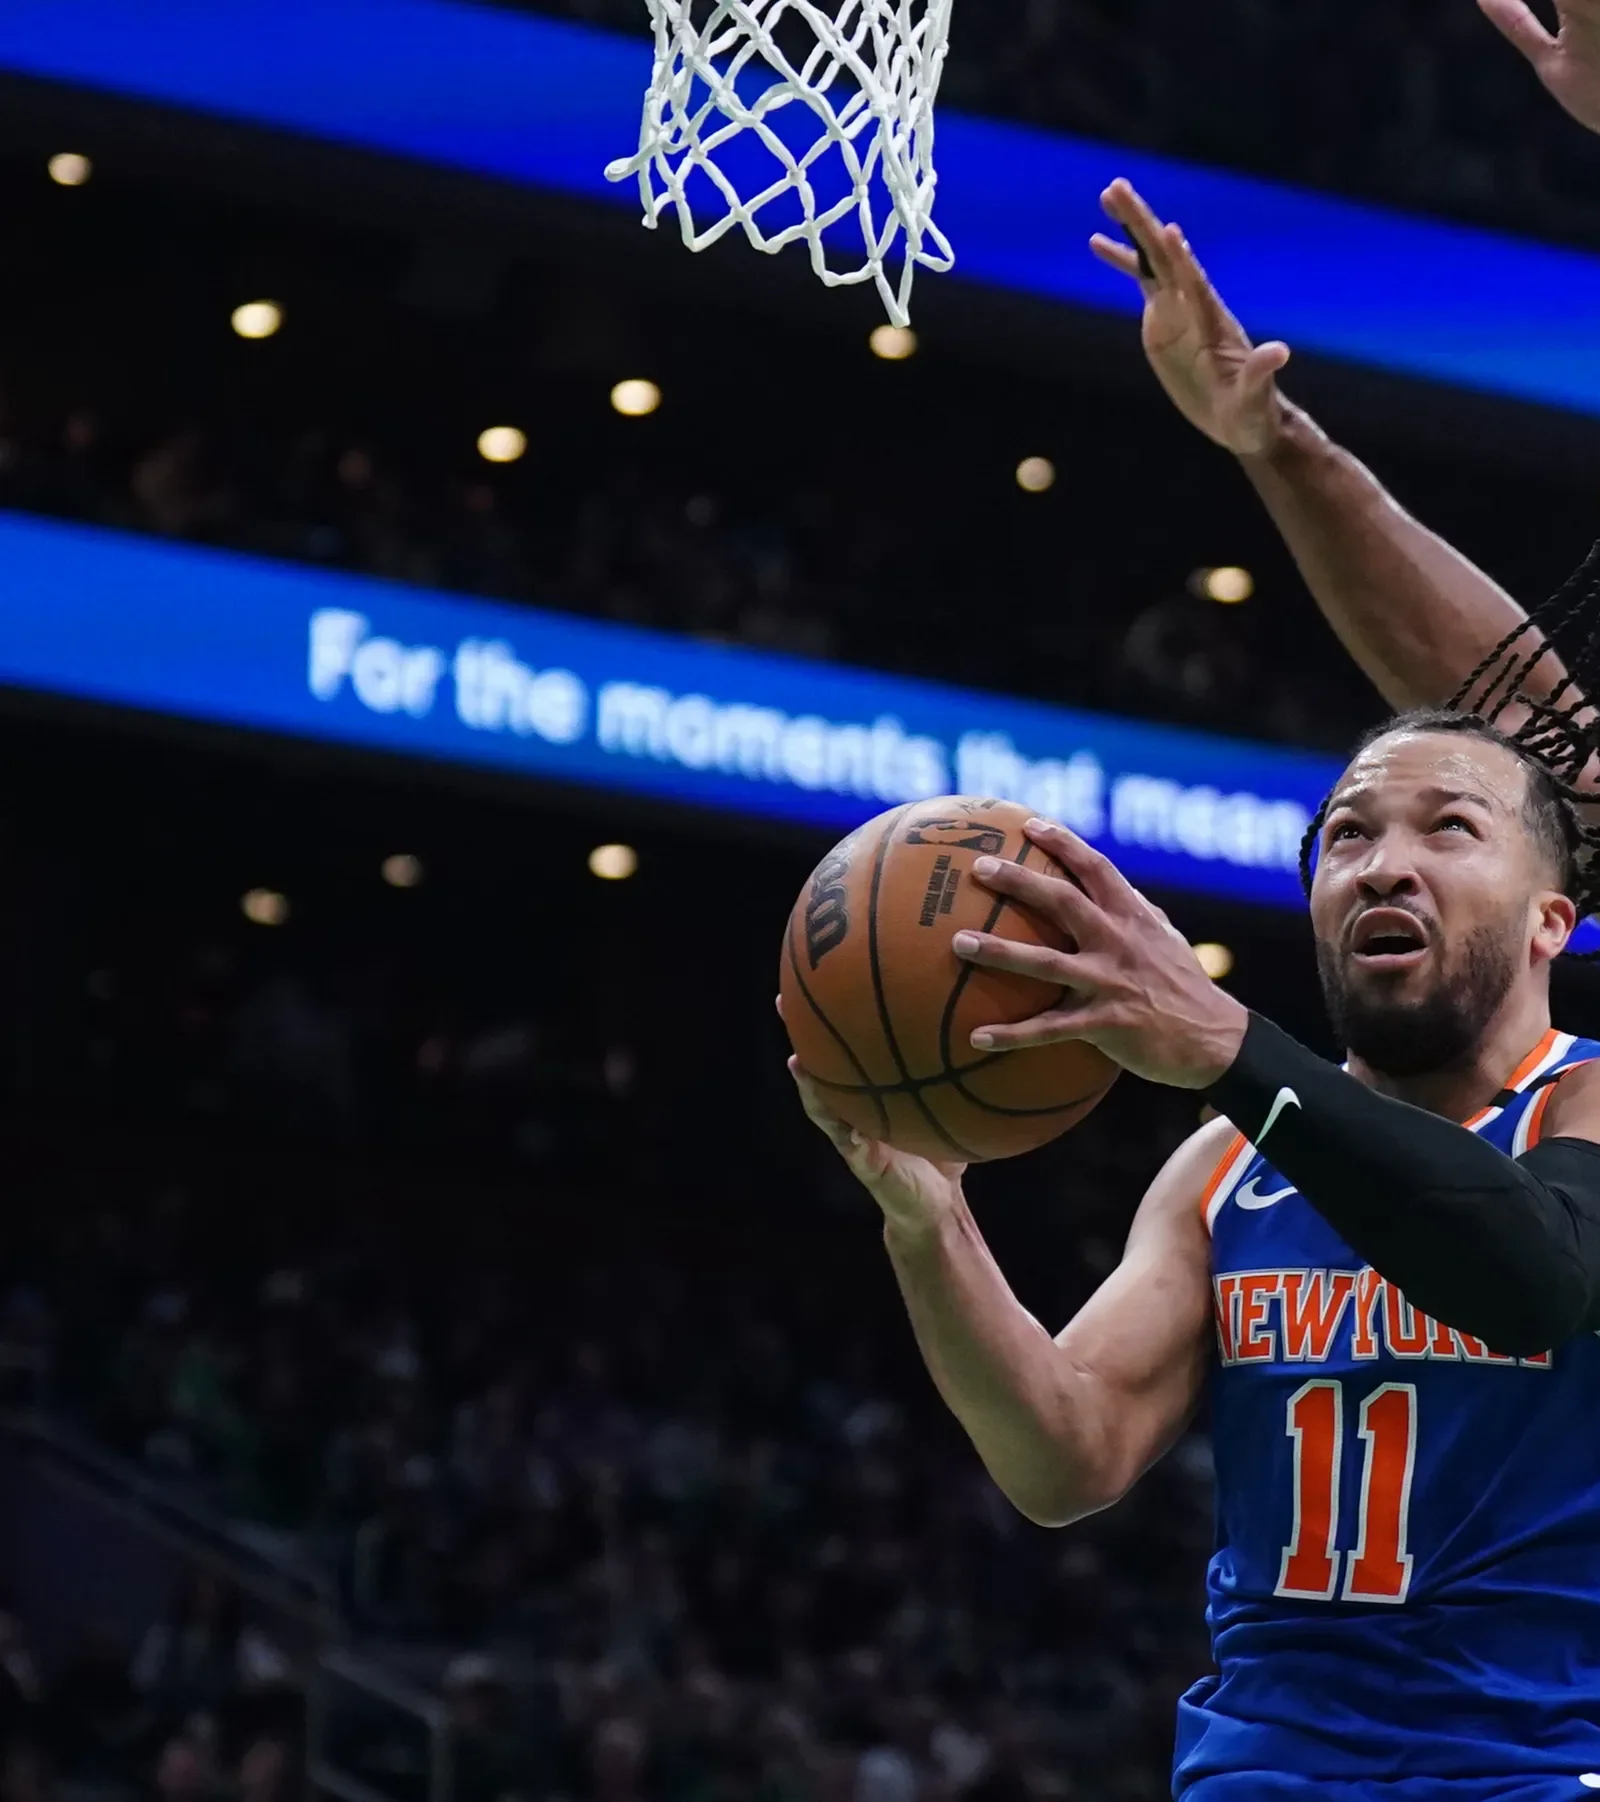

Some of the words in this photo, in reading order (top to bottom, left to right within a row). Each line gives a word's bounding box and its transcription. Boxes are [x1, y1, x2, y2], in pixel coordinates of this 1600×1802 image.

[308, 607, 446, 719] For
[452, 635, 589, 746] the
[597, 680, 953, 809] moments
[955, 730, 1104, 838] that
[1108, 771, 1312, 874] mean
[1273, 1378, 1418, 1605] 11
